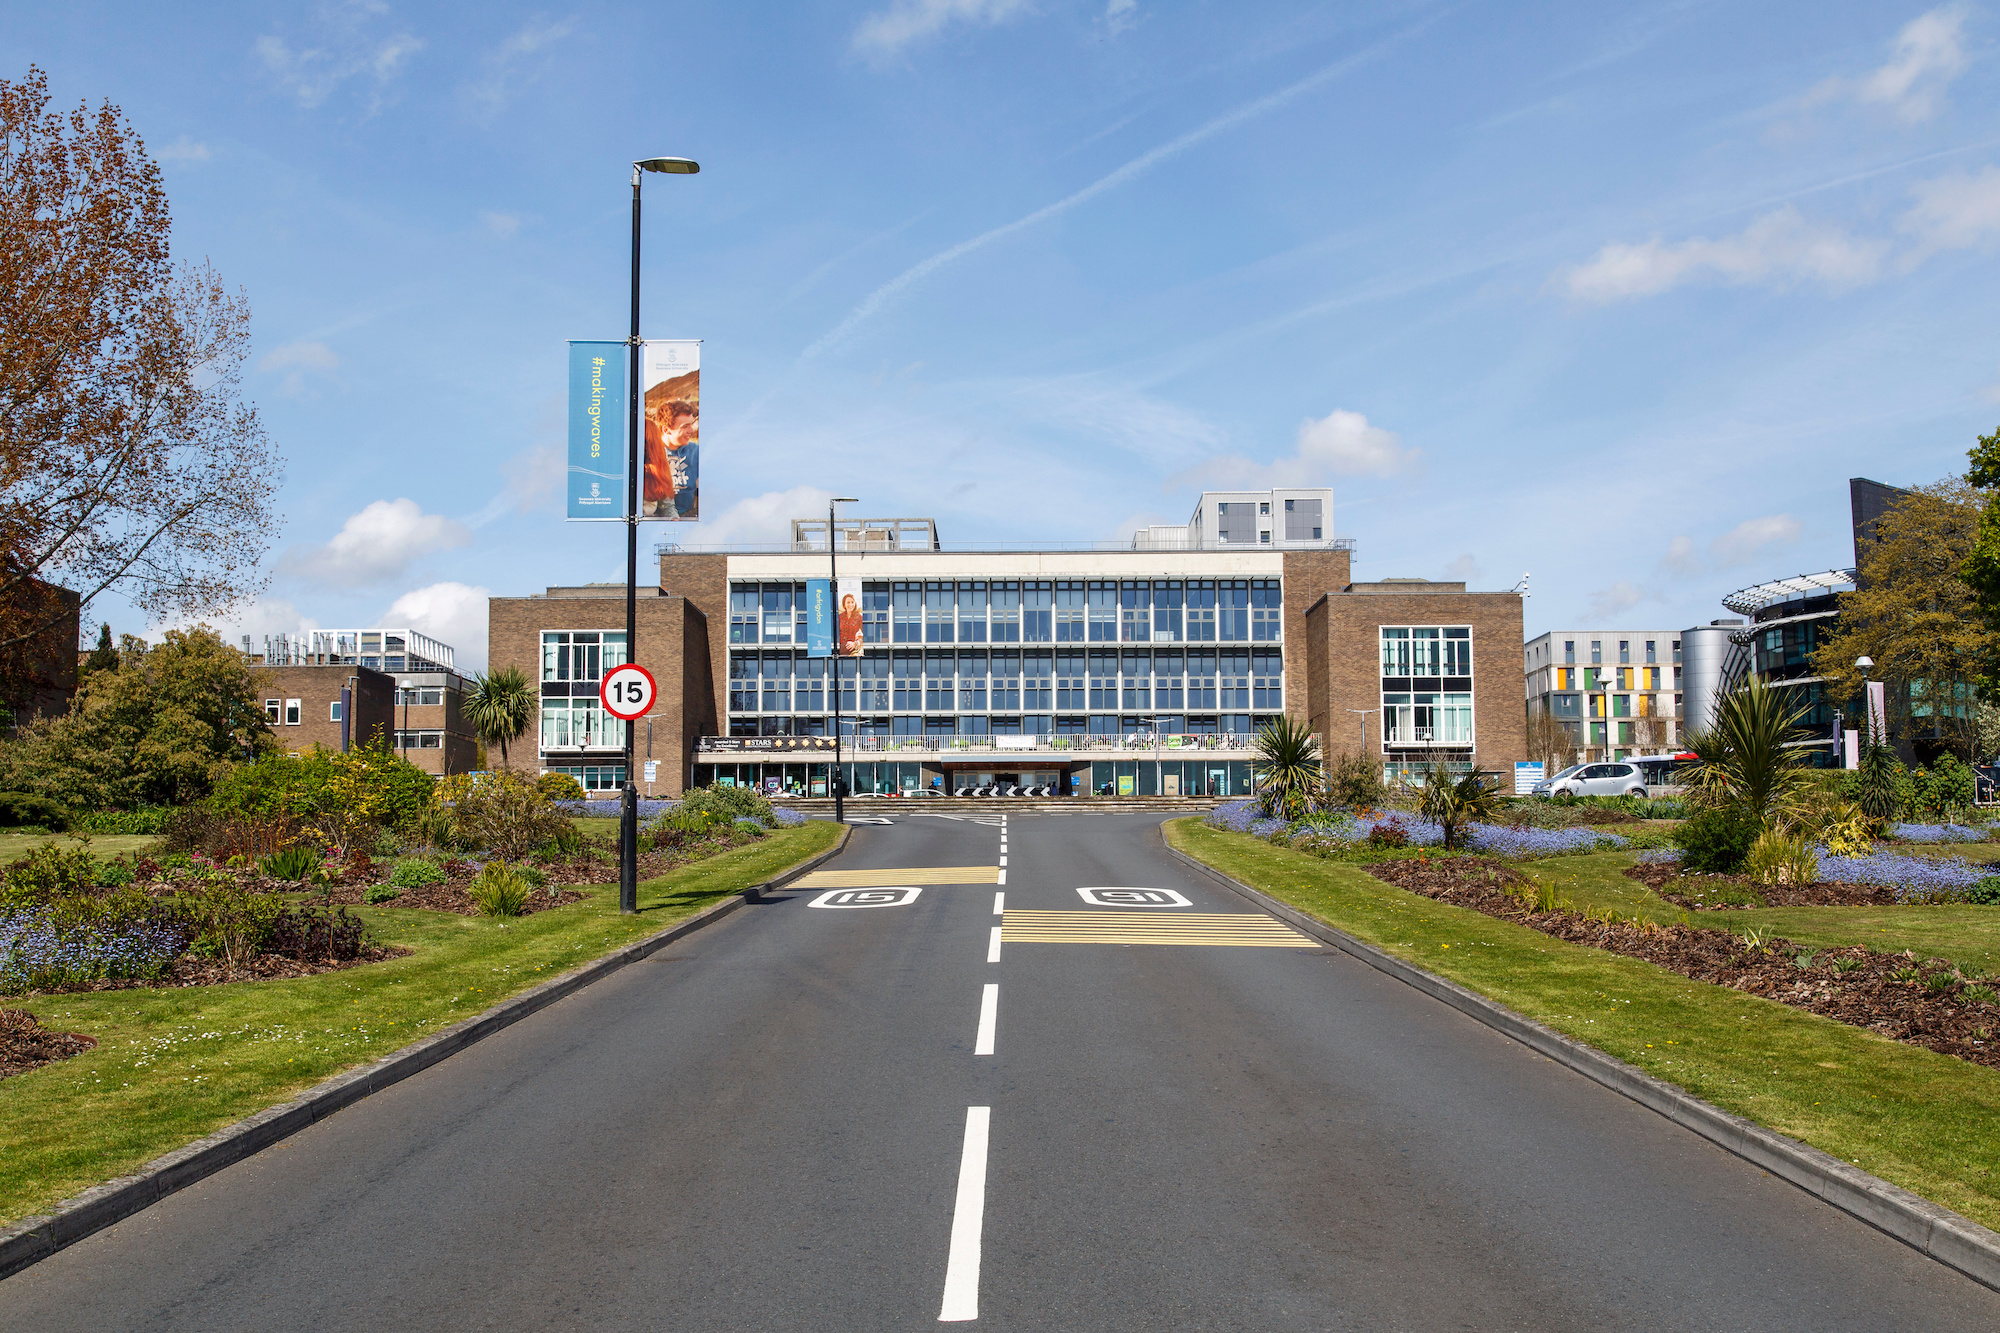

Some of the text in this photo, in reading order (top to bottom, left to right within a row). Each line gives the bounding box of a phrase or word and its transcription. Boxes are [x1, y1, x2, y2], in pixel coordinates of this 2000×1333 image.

[588, 357, 606, 458] #makingwaves
[613, 681, 643, 704] 15
[836, 892, 895, 902] 15
[1101, 892, 1164, 902] 15
